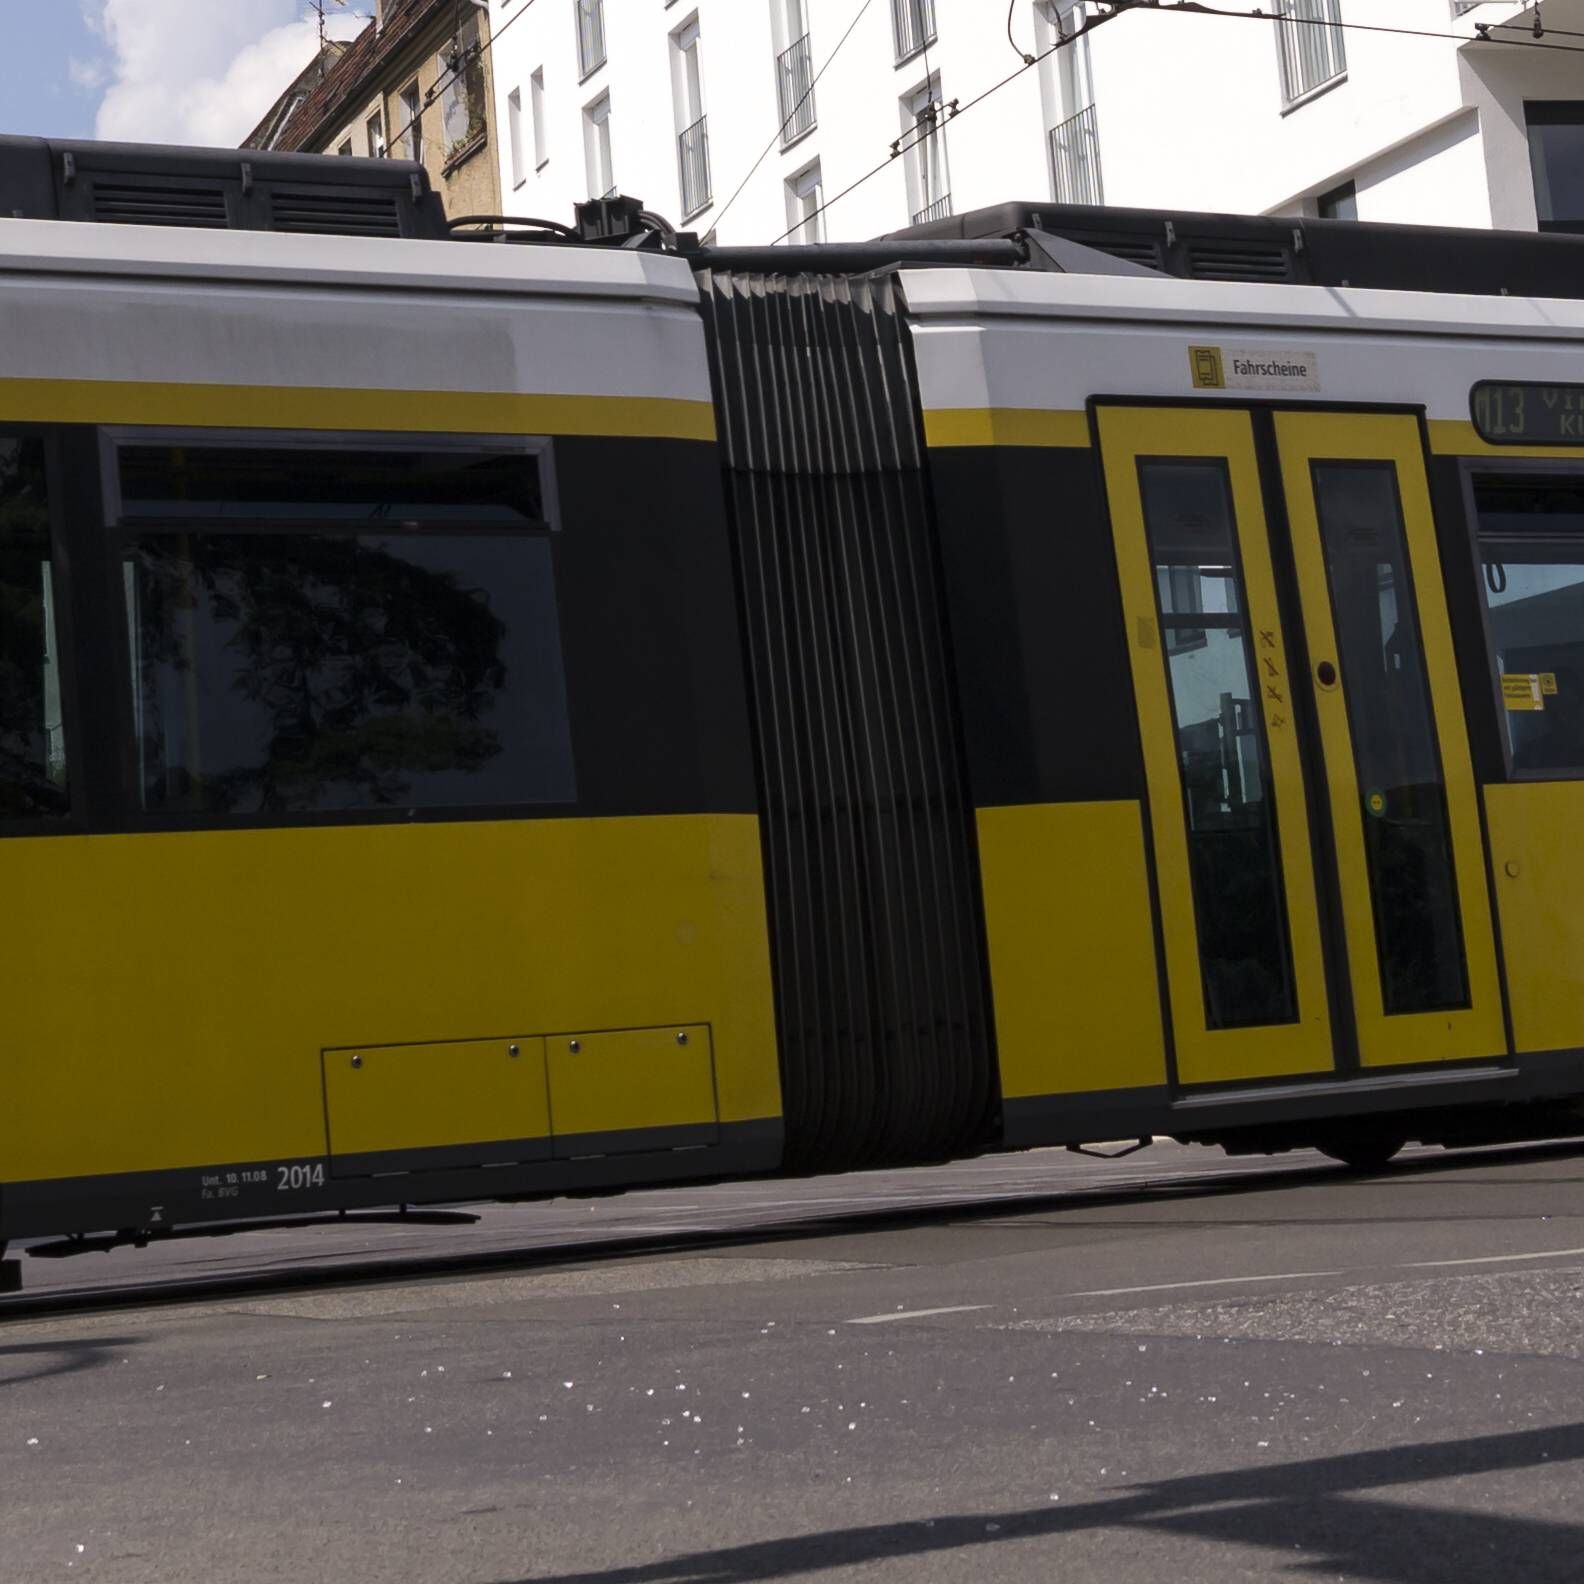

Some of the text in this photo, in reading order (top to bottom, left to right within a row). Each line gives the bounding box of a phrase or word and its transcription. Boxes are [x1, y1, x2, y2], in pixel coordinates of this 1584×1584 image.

[1232, 359, 1307, 377] Fahrscheine
[1475, 387, 1524, 434] M13
[277, 1163, 325, 1190] 2014
